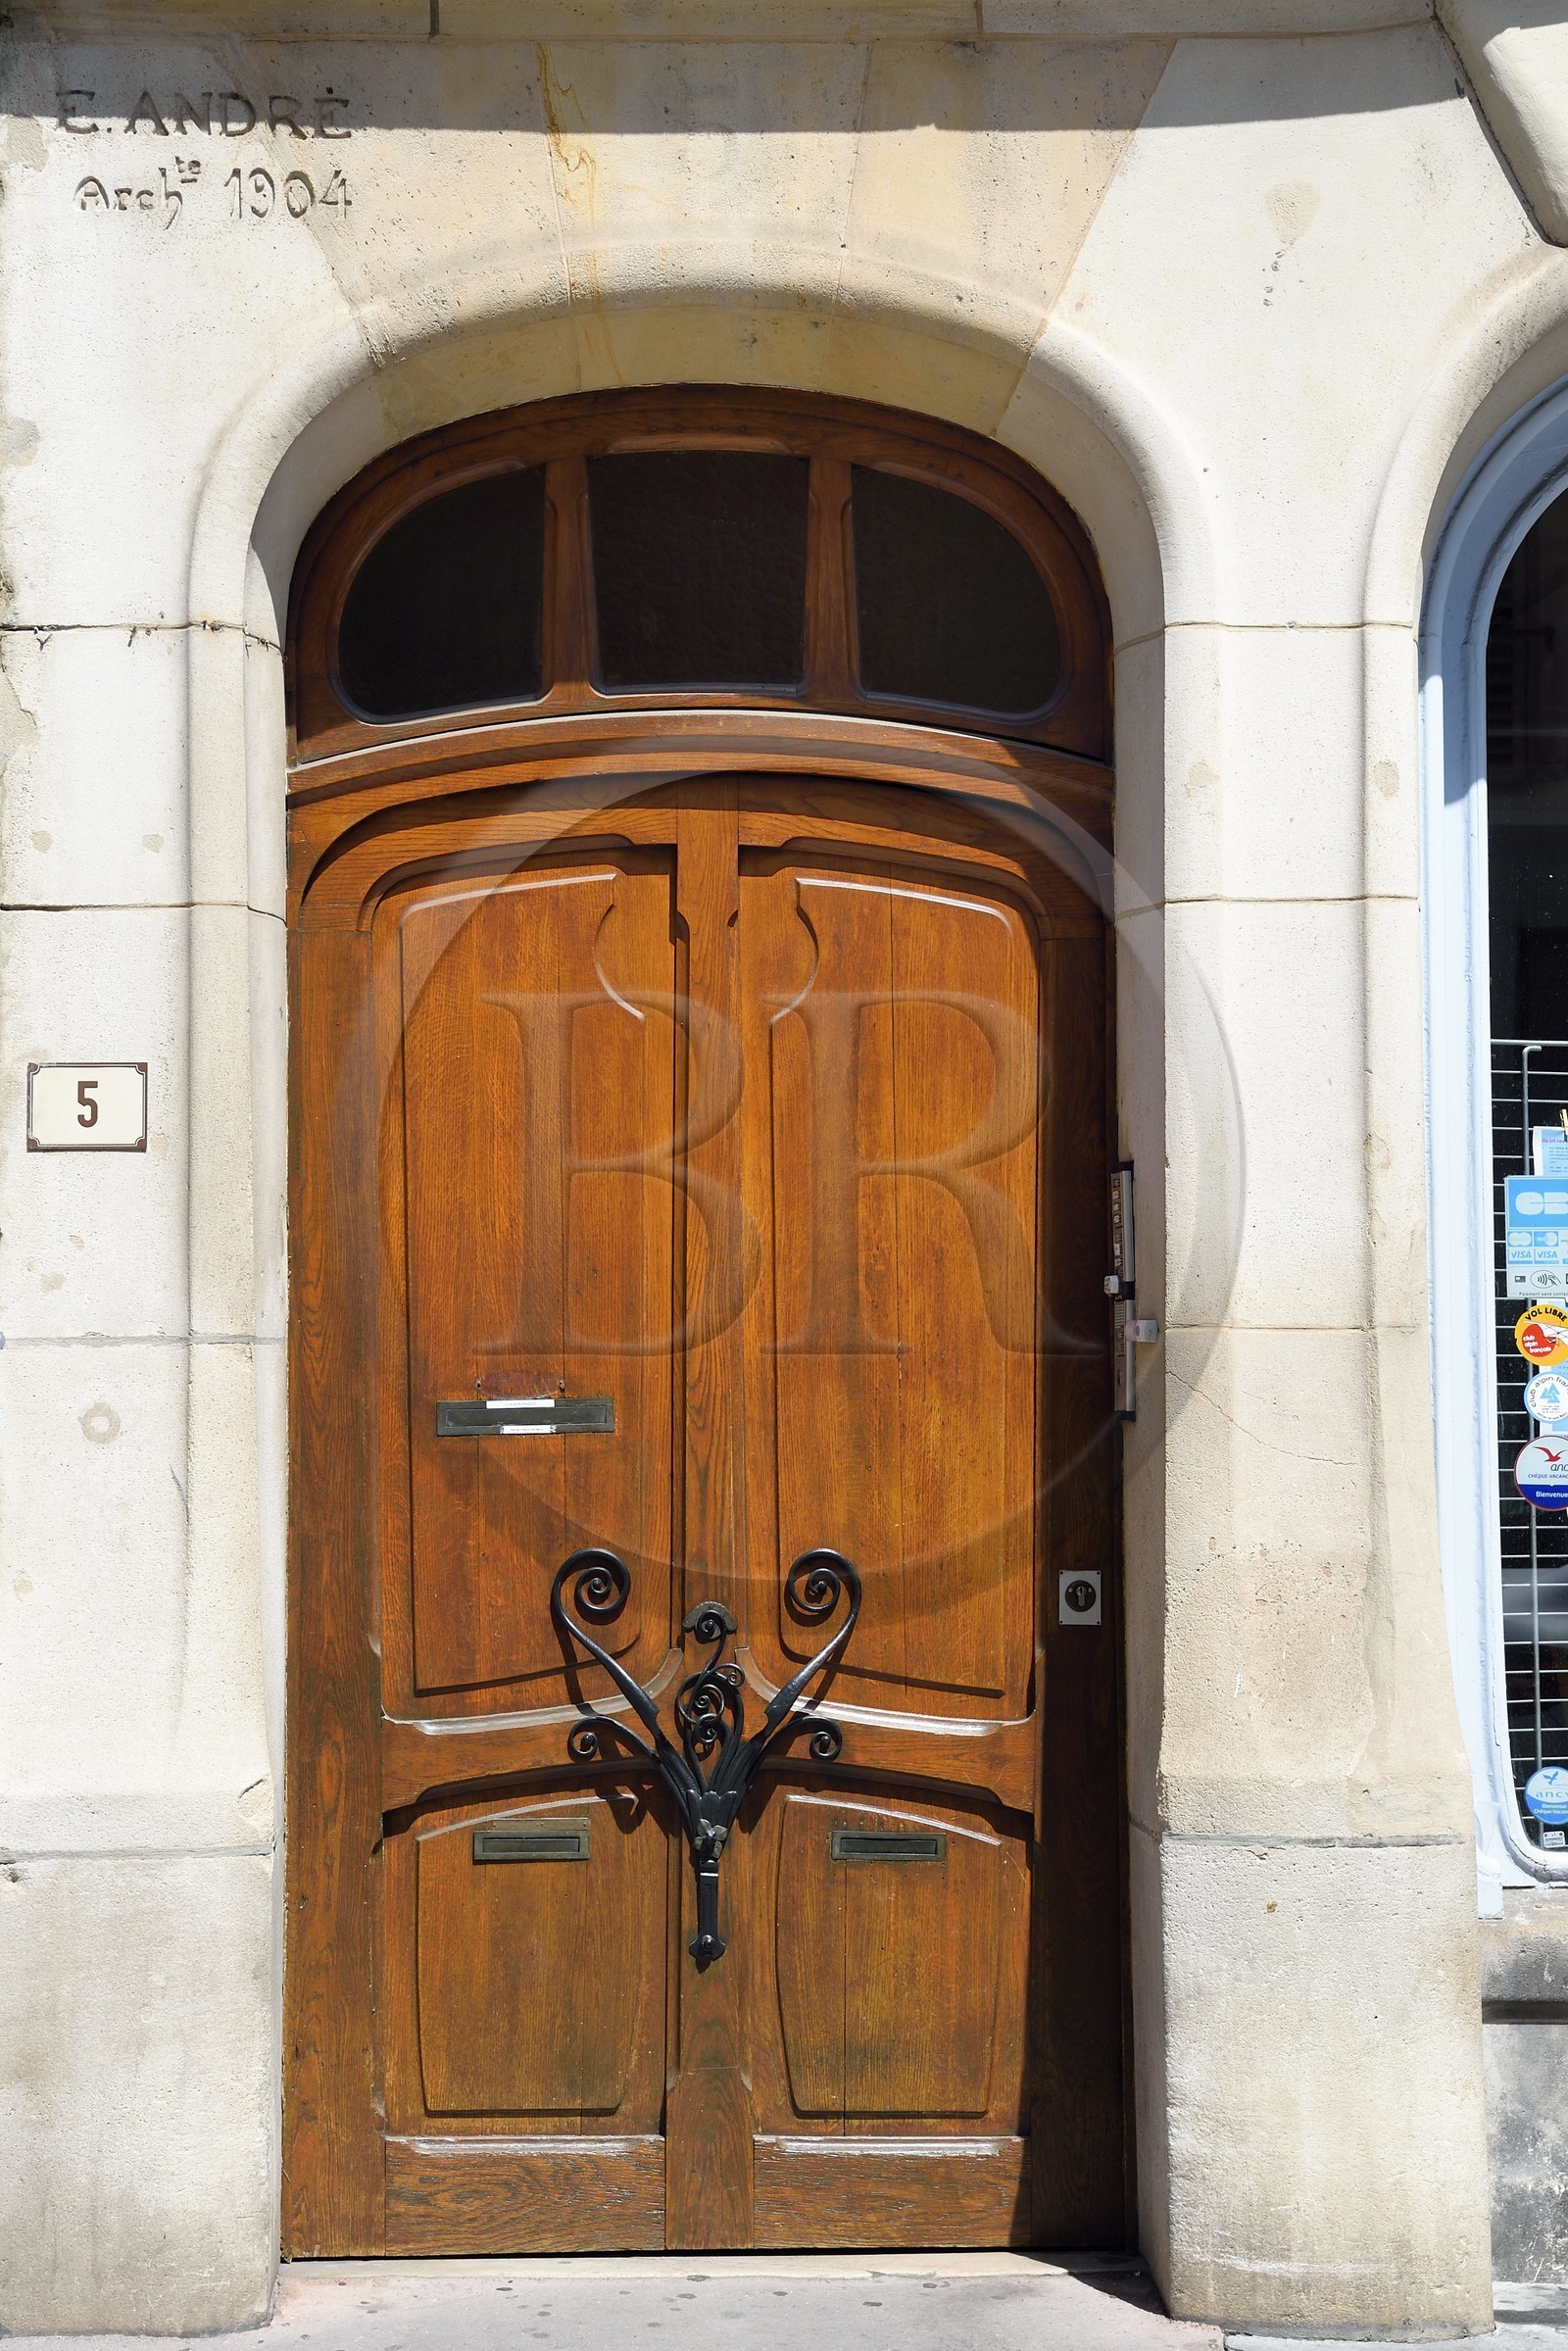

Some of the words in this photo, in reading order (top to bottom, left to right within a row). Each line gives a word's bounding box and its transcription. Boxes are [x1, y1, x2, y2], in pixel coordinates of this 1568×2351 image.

[224, 168, 353, 220] 1904
[77, 1080, 99, 1128] 5
[1511, 1250, 1532, 1259] VISA
[1538, 1250, 1558, 1259] VISA
[1525, 1308, 1543, 1321] VOL
[1544, 1307, 1568, 1322] LIBRE
[1535, 1376, 1554, 1388] alpin
